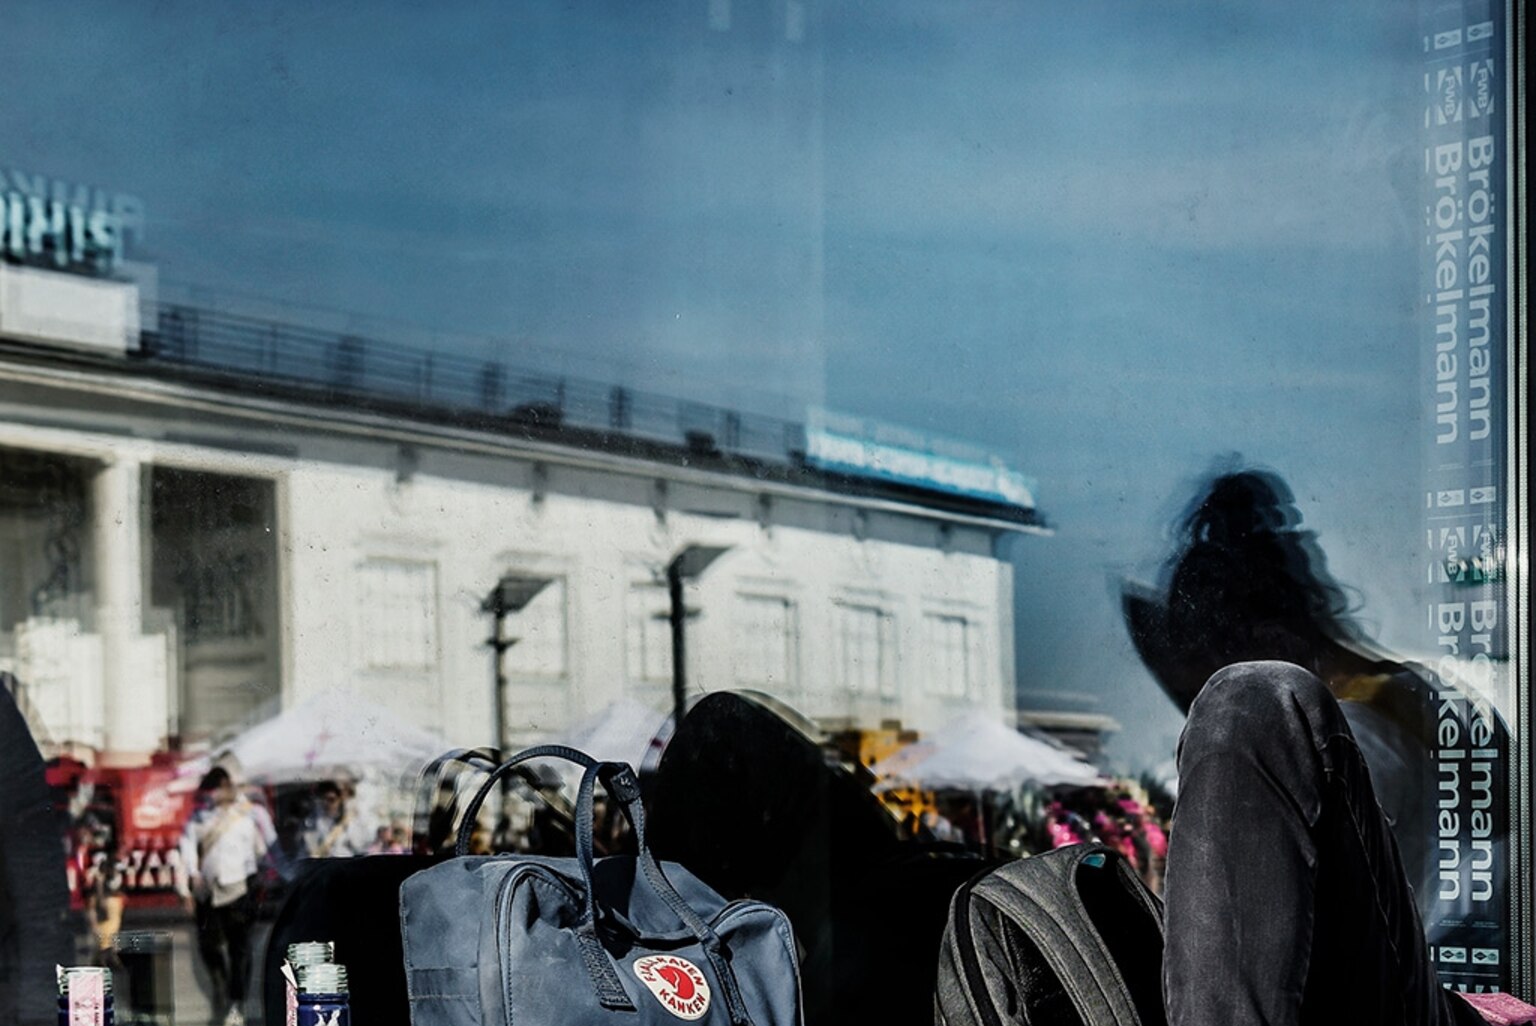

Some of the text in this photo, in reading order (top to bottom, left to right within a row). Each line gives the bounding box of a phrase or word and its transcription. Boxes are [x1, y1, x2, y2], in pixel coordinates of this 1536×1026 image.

[1434, 140, 1464, 445] Brökelmann
[1467, 135, 1496, 441] Brökelmann
[1436, 602, 1466, 902] Brökelmann
[1470, 599, 1499, 902] Brökelmann
